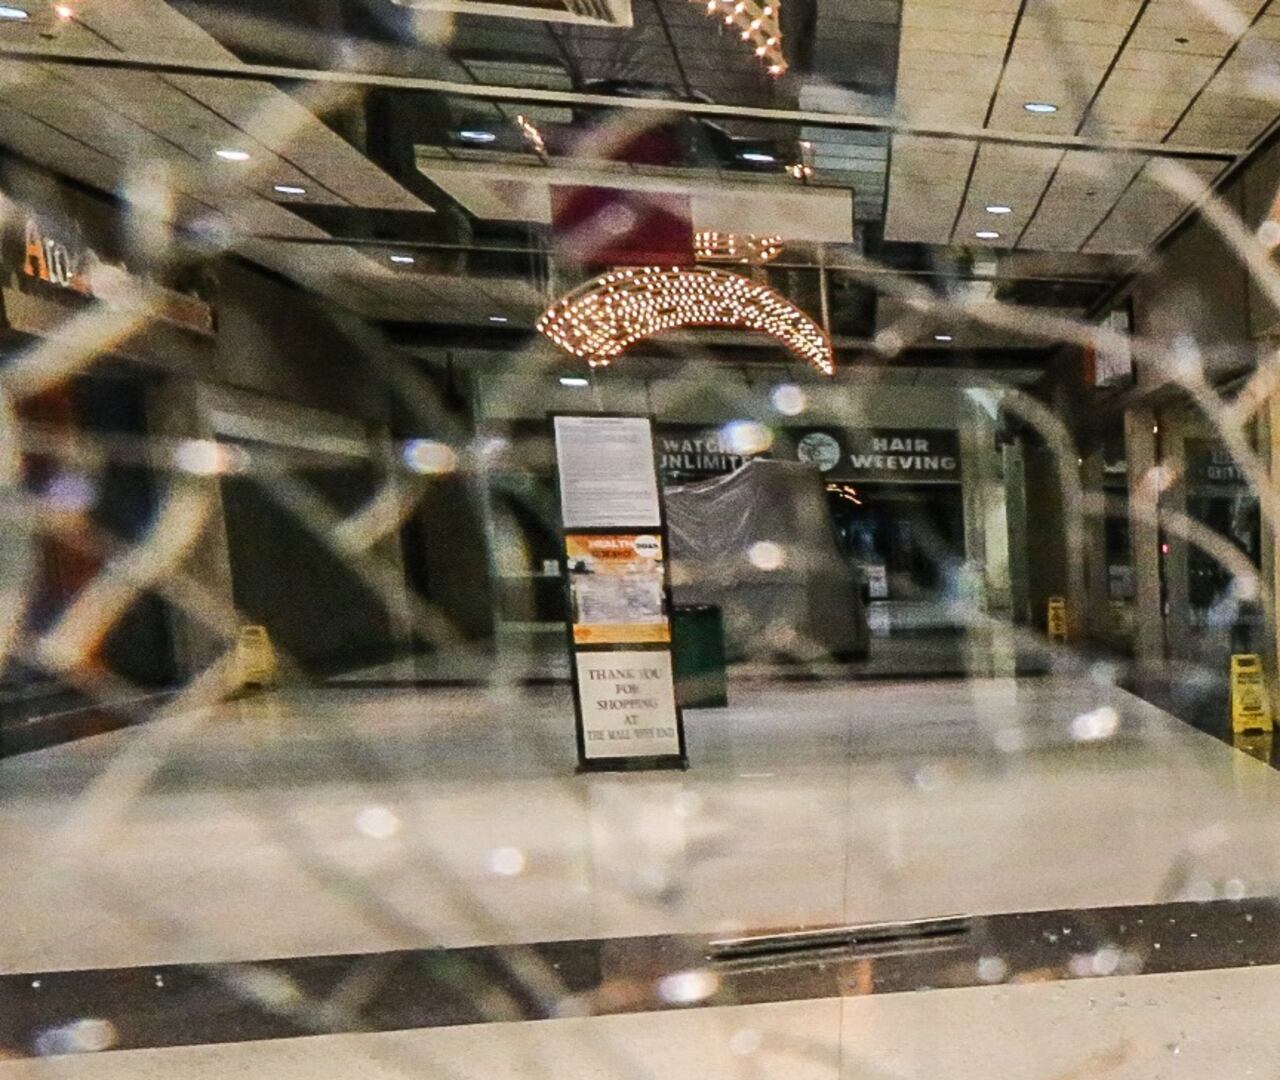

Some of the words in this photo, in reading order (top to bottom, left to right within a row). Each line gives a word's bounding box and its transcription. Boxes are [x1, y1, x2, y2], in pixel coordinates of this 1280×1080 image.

[663, 439, 729, 454] WATC
[873, 438, 929, 452] HAIR
[660, 454, 751, 470] UNLIMIT
[850, 454, 956, 470] WEEVING
[588, 669, 634, 680] THANK
[641, 669, 661, 679] YOU
[616, 684, 639, 695] FOR
[597, 698, 658, 711] SHOPPING
[624, 715, 638, 725] AT
